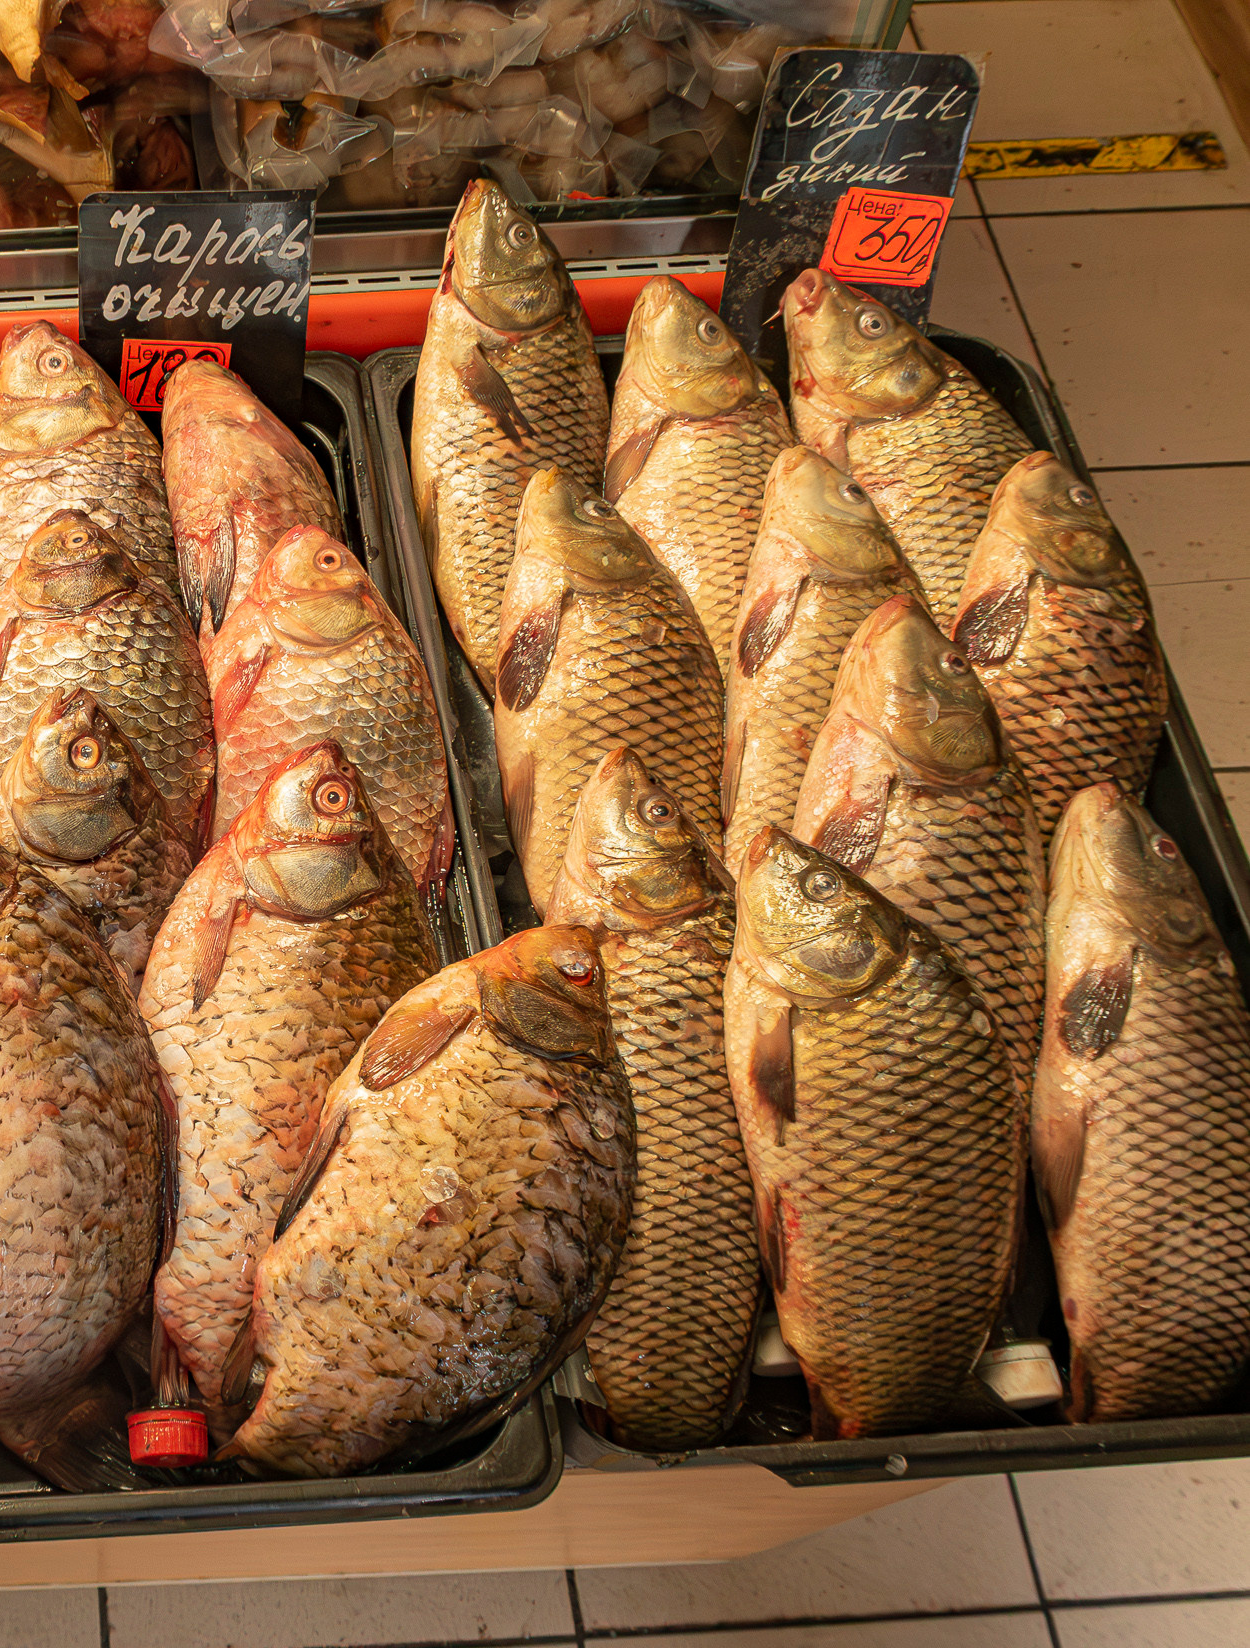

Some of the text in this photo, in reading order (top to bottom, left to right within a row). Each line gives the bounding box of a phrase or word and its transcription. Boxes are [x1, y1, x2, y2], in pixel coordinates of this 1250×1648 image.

[786, 62, 967, 164] Сазан
[761, 151, 926, 201] дикий
[847, 193, 904, 218] Цена:
[109, 204, 309, 288] Карась
